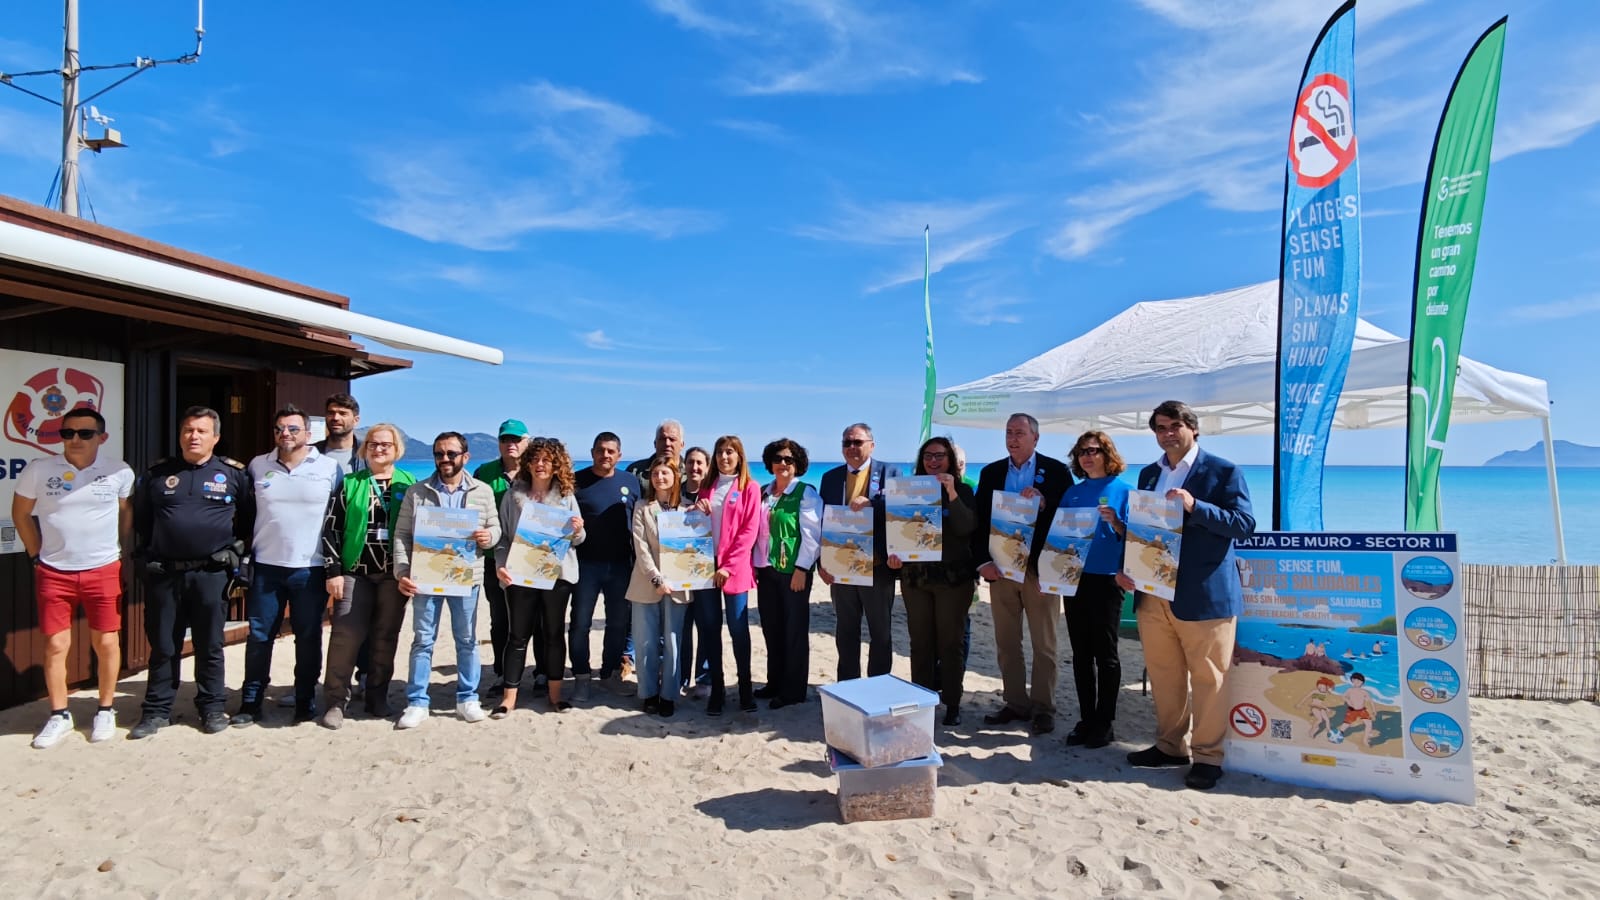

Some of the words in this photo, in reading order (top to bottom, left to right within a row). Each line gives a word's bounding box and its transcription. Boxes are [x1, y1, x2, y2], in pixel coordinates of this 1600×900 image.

[1289, 226, 1341, 255] SENSE
[1293, 256, 1325, 280] FUM
[1294, 292, 1349, 318] PLAYAS
[1292, 321, 1317, 342] SIN
[1287, 347, 1328, 367] HUMO
[1235, 536, 1276, 547] LATJA
[1280, 536, 1300, 547] DE
[1304, 536, 1352, 548] MURO
[1365, 537, 1431, 548] SECTOR
[1435, 537, 1445, 549] II
[1279, 559, 1314, 573] SENSE
[1316, 560, 1344, 576] FUM,
[1292, 575, 1382, 593] SALUDABLES
[1330, 597, 1382, 608] SALUDABLES
